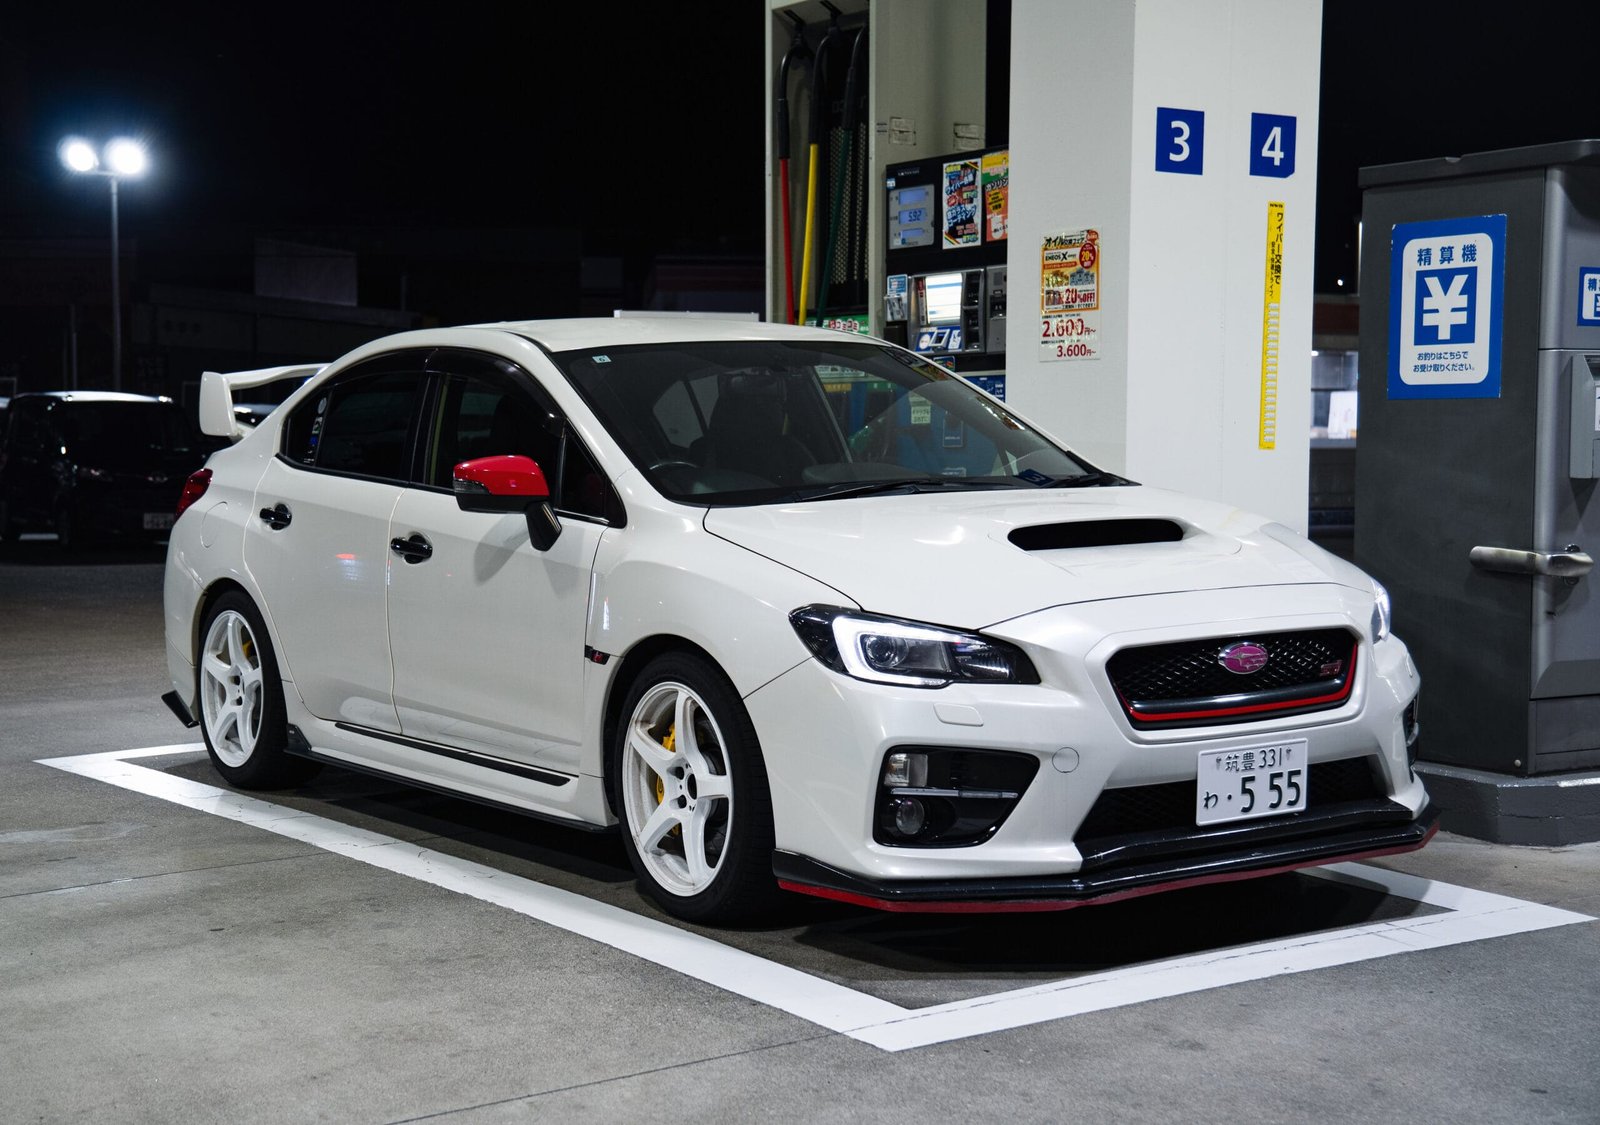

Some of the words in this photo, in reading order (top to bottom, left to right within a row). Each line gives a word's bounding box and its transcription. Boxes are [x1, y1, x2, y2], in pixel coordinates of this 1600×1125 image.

[1169, 120, 1190, 162] 3
[1261, 126, 1284, 166] 4
[1274, 212, 1284, 285] ワイパー交換で
[1417, 244, 1477, 266] 精算機
[1413, 363, 1475, 373] お受け取りください。
[1417, 350, 1469, 361] お釣りはこちらで
[1225, 752, 1255, 772] 筑豊
[1258, 747, 1283, 768] 331
